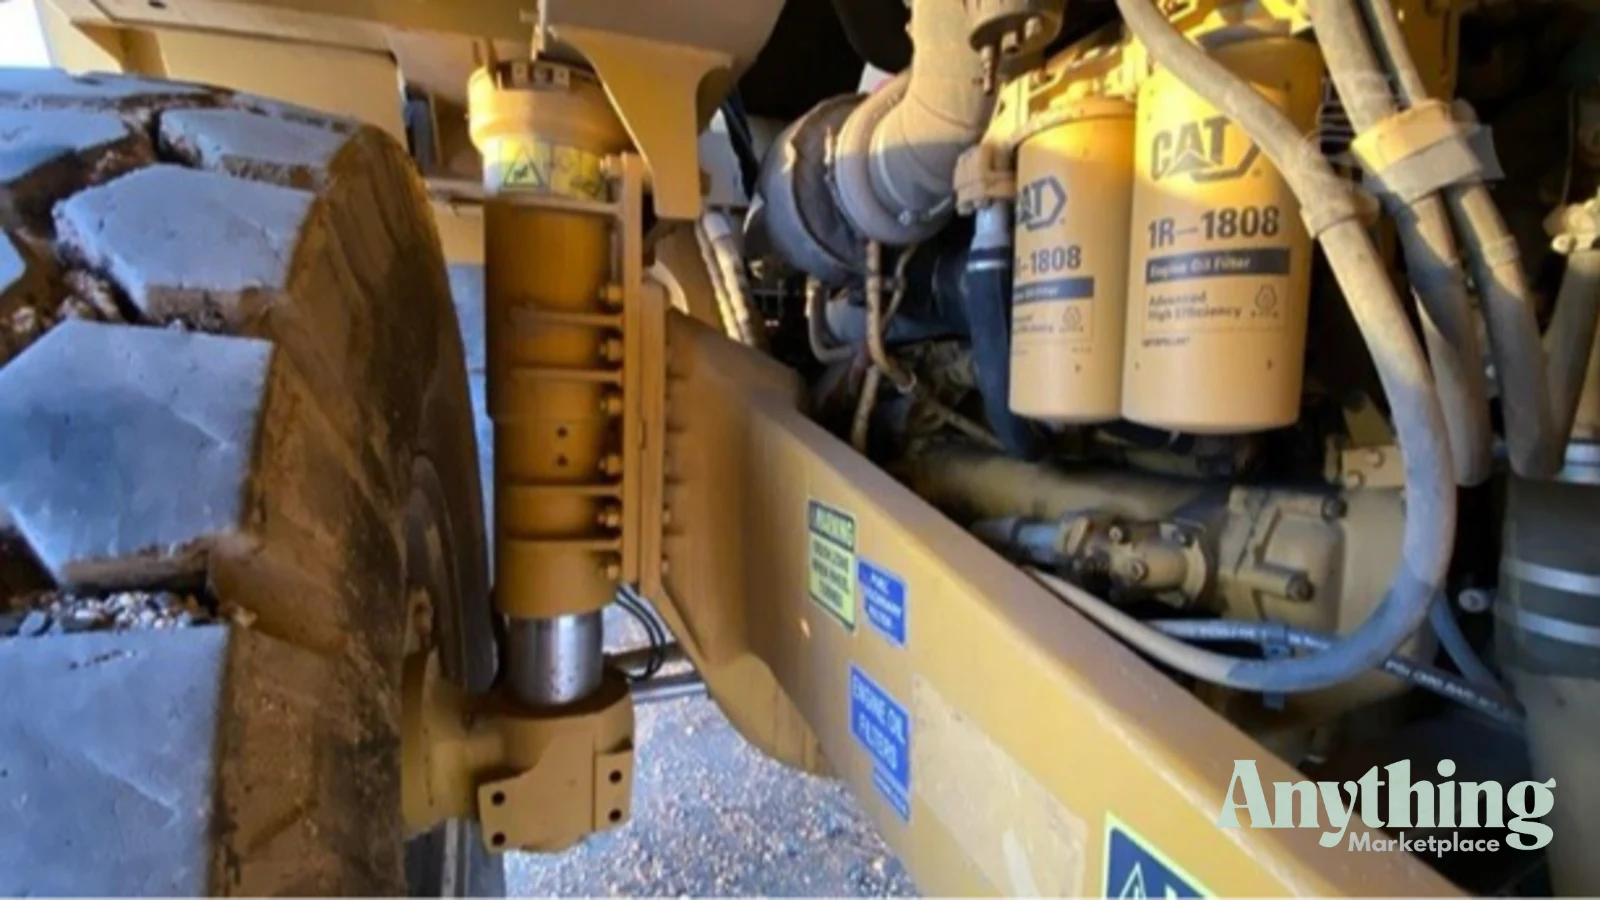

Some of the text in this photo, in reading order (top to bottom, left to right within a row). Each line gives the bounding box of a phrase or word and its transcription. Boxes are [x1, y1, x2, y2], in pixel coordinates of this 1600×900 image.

[1151, 116, 1232, 181] CAT
[1213, 256, 1251, 272] Filter
[1148, 309, 1172, 323] High
[1175, 305, 1243, 319] Efficiency
[1149, 291, 1207, 307] Advanced
[852, 674, 887, 726] ENGINE
[858, 711, 898, 770] FILTERS
